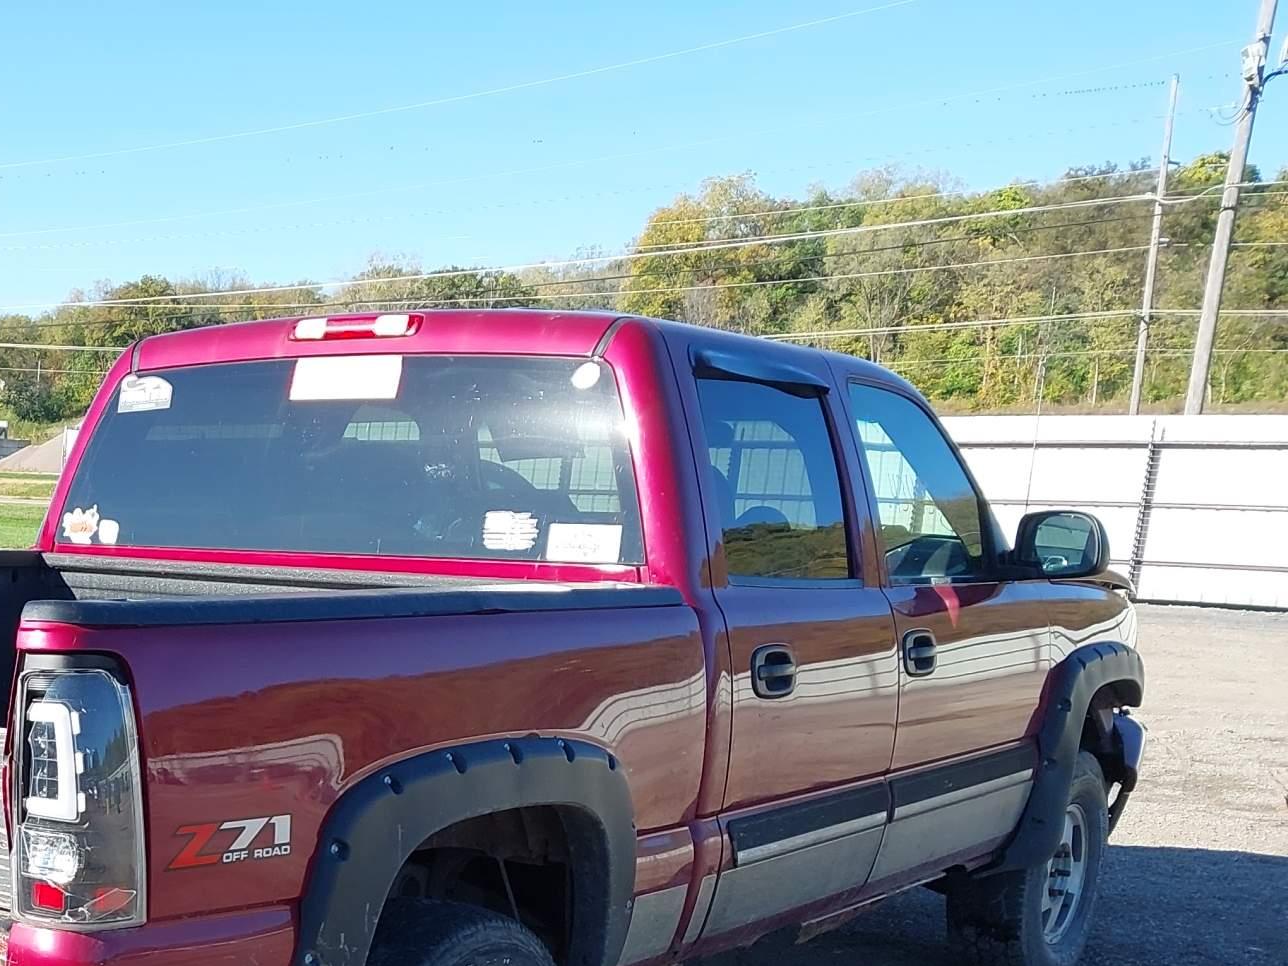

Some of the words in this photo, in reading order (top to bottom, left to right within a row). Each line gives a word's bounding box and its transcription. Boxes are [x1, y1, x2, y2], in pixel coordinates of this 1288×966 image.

[168, 814, 292, 869] Z71
[222, 850, 249, 863] OFF
[254, 845, 291, 859] ROAD
